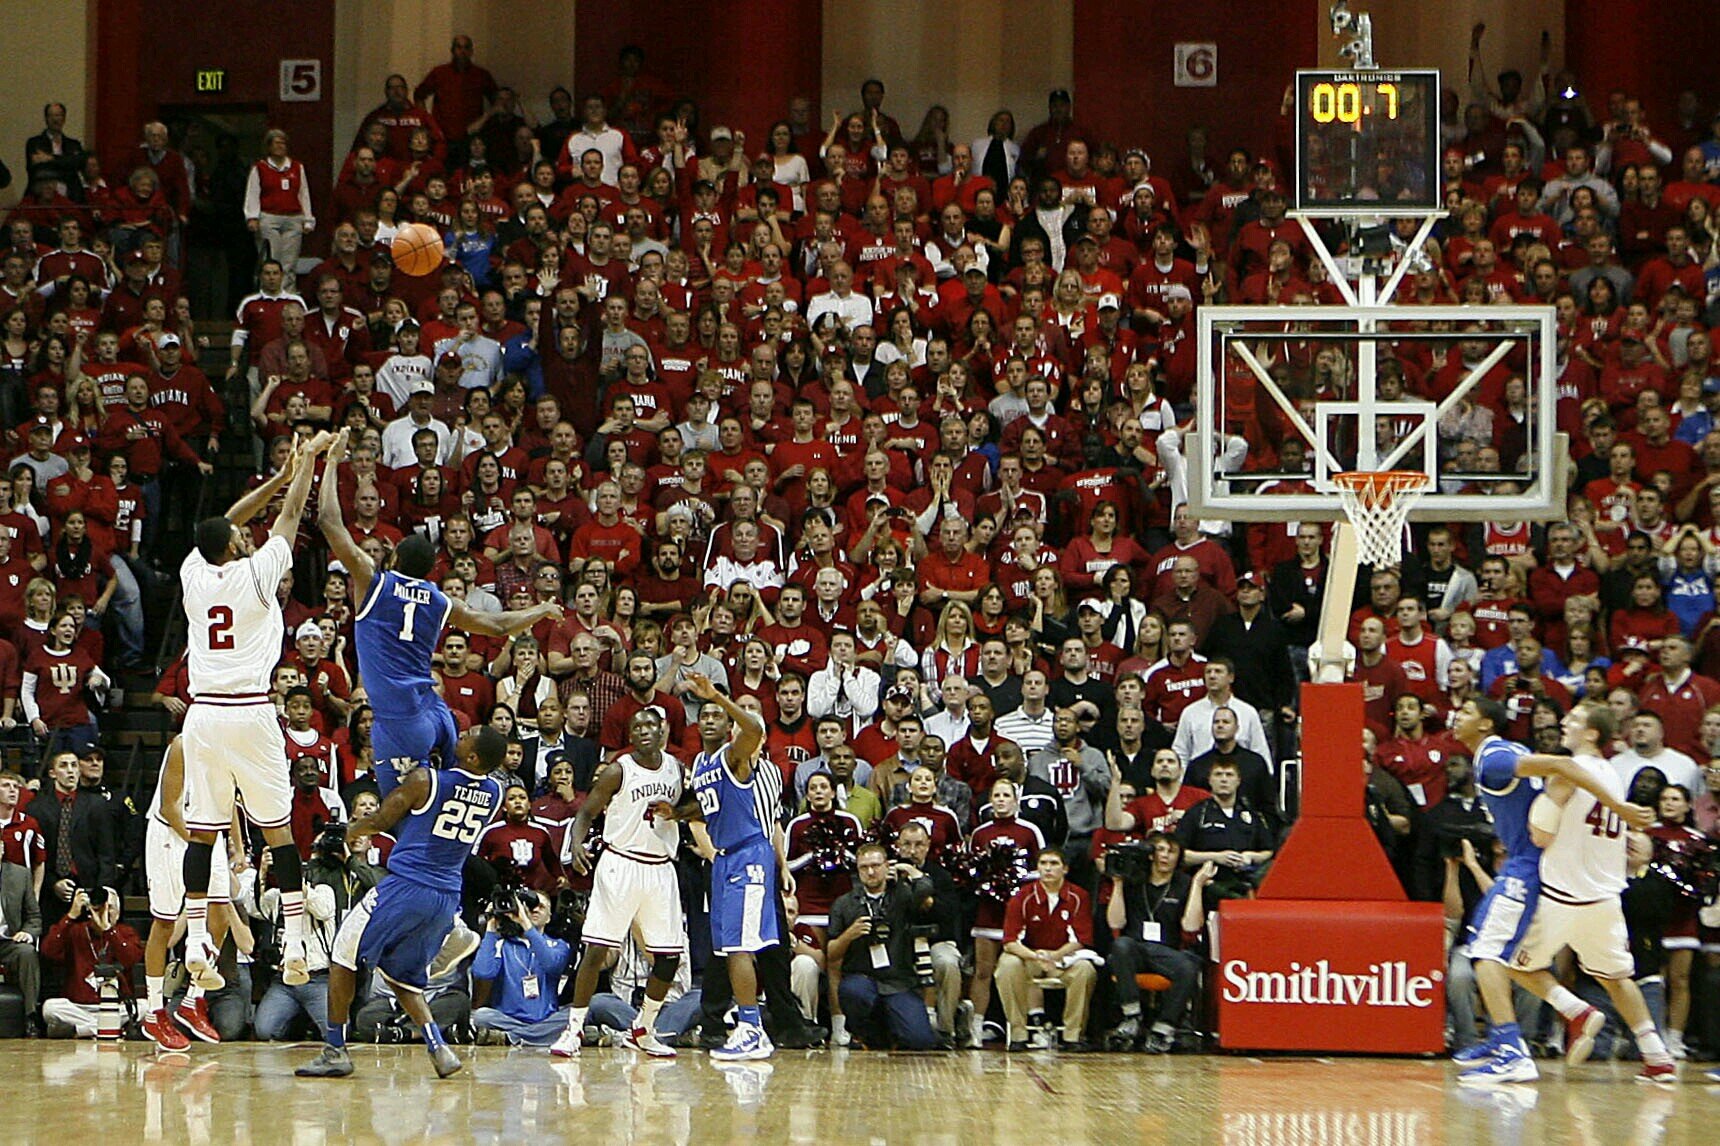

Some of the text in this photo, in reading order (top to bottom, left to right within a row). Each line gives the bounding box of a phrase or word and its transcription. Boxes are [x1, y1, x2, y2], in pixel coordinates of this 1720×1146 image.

[291, 64, 316, 95] 5
[1186, 49, 1212, 80] 6
[198, 71, 224, 91] EXIT
[150, 389, 188, 408] INDIANA
[393, 582, 432, 604] MILLER
[208, 606, 234, 650] 2
[399, 602, 416, 642] 1
[454, 784, 493, 807] TEAGUE
[631, 783, 676, 803] INDIANA
[696, 787, 720, 816] 20
[432, 800, 491, 845] 25
[1585, 800, 1624, 840] 40
[1222, 960, 1433, 1008] Smithville
